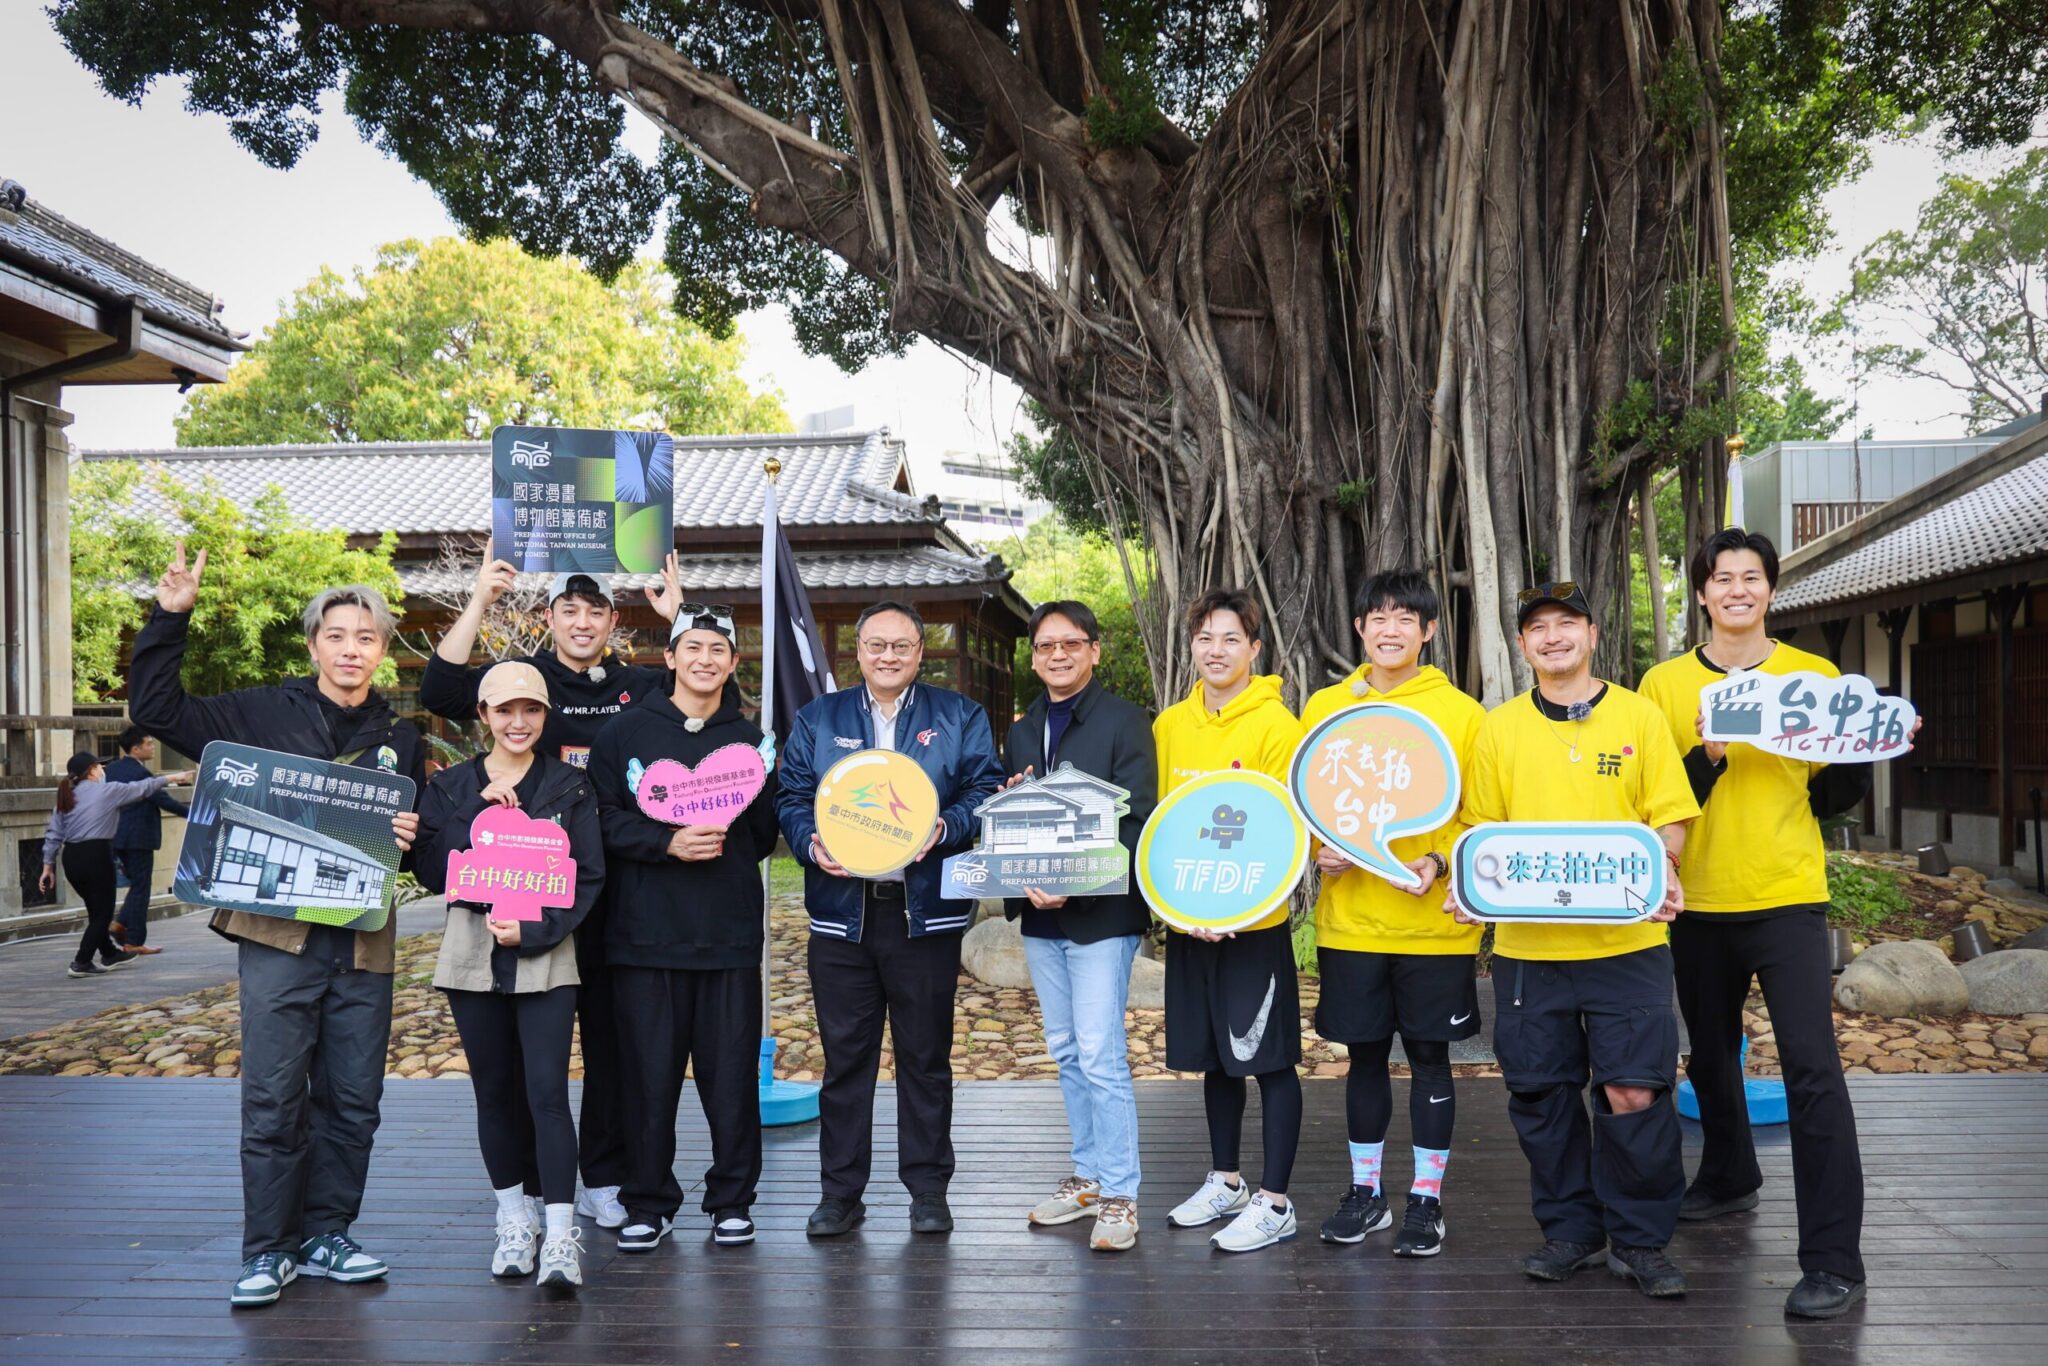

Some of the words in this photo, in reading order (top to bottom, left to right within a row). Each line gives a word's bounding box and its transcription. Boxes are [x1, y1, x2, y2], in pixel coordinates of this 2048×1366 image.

[513, 482, 576, 504] 國家漫畫
[514, 507, 607, 529] 博物館籌備處
[514, 531, 562, 539] PREPARATORY
[563, 532, 587, 540] OFFICE
[514, 541, 548, 549] NATIONAL
[577, 542, 607, 550] MUSEUM
[1597, 753, 1622, 777] 玩
[271, 766, 402, 806] 國家漫畫博物館籌備處
[269, 786, 329, 803] PREPARATORY
[331, 798, 359, 810] OFFICE
[360, 803, 373, 812] OF
[373, 806, 397, 816] NTMC
[672, 791, 744, 817] 台中好好拍
[1334, 788, 1397, 842] 台中
[459, 864, 568, 896] 台中好好拍
[1001, 876, 1058, 886] PREPARATORY
[1059, 875, 1087, 884] OFFICE
[1173, 858, 1267, 895] TFDF
[1506, 850, 1650, 885] 來去拍台中
